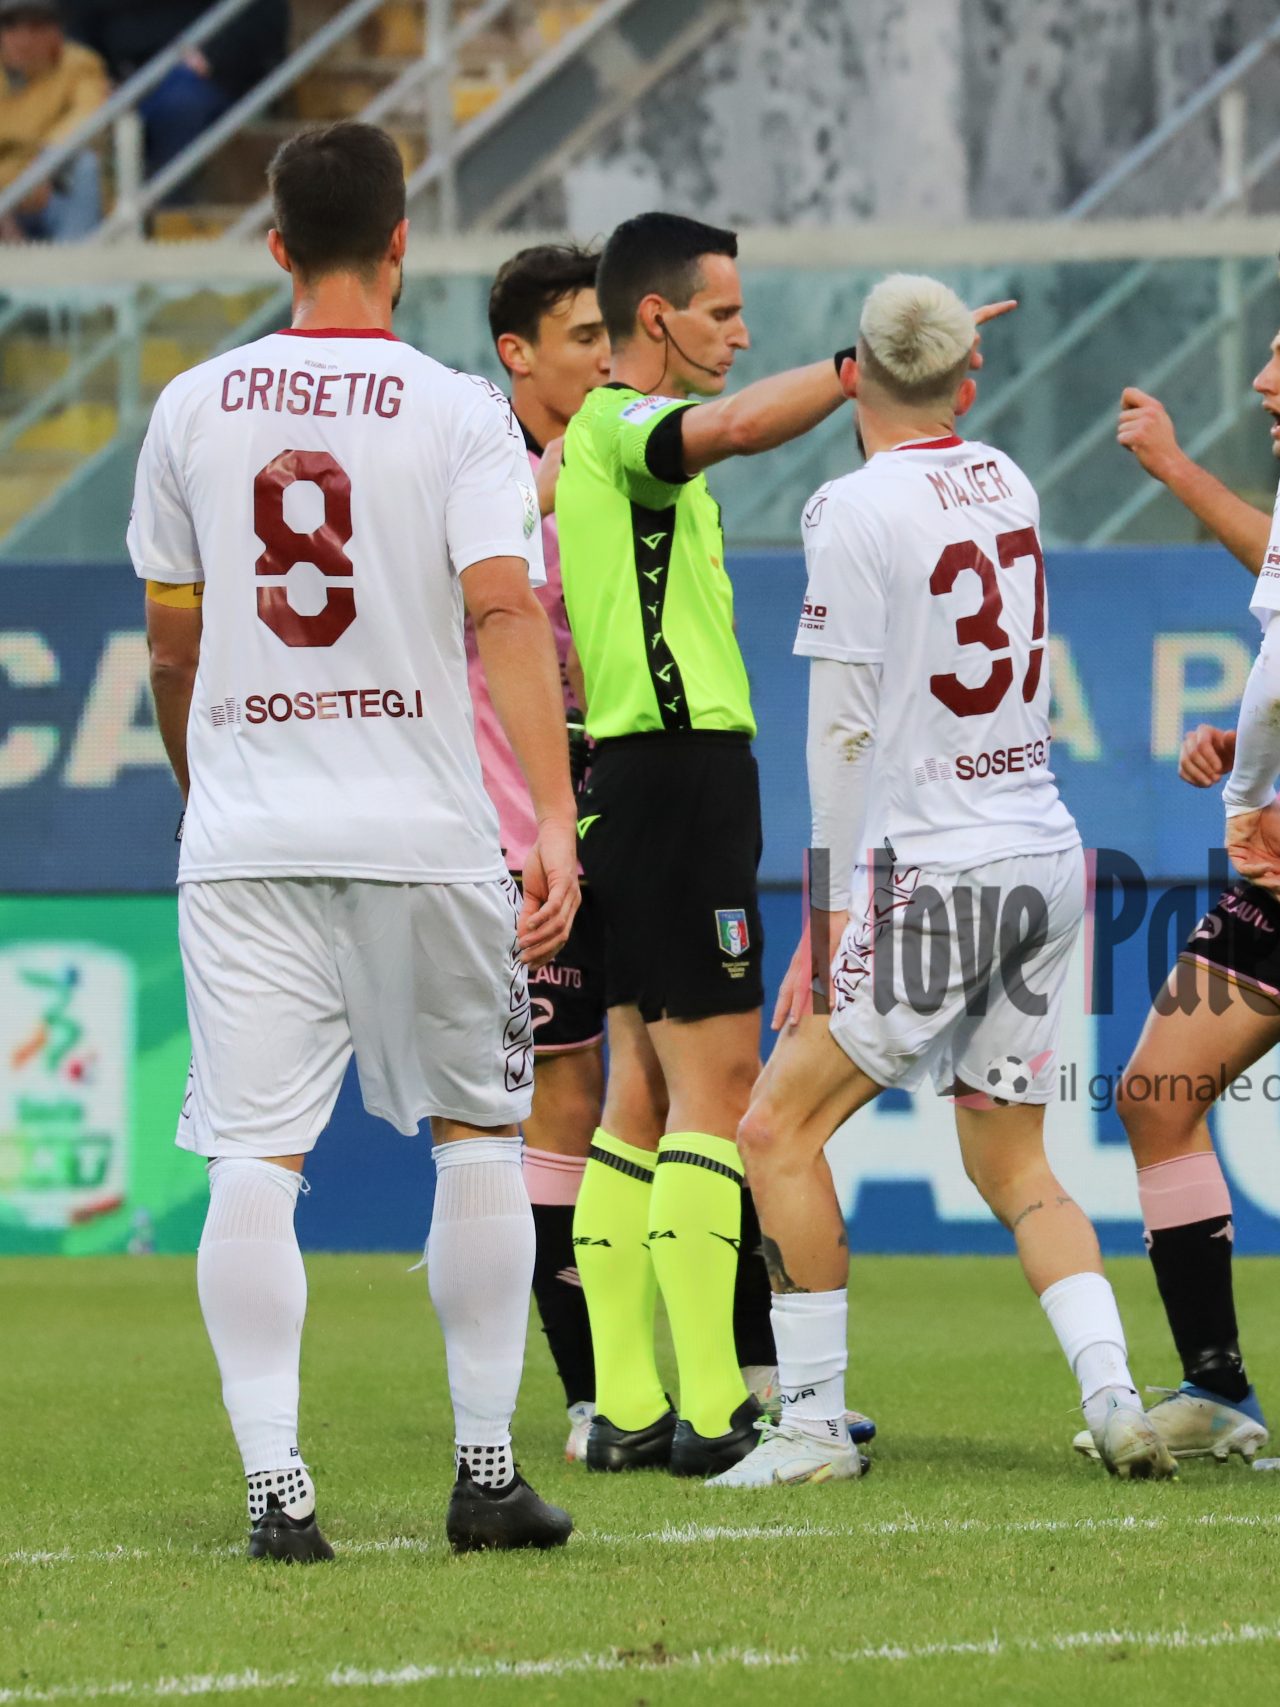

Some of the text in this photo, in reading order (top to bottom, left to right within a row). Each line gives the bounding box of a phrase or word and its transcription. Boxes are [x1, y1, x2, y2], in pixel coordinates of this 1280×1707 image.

[221, 367, 404, 419] CRISETIG
[925, 460, 1013, 510] MAJER
[254, 449, 357, 647] 8
[929, 526, 1045, 718] 37
